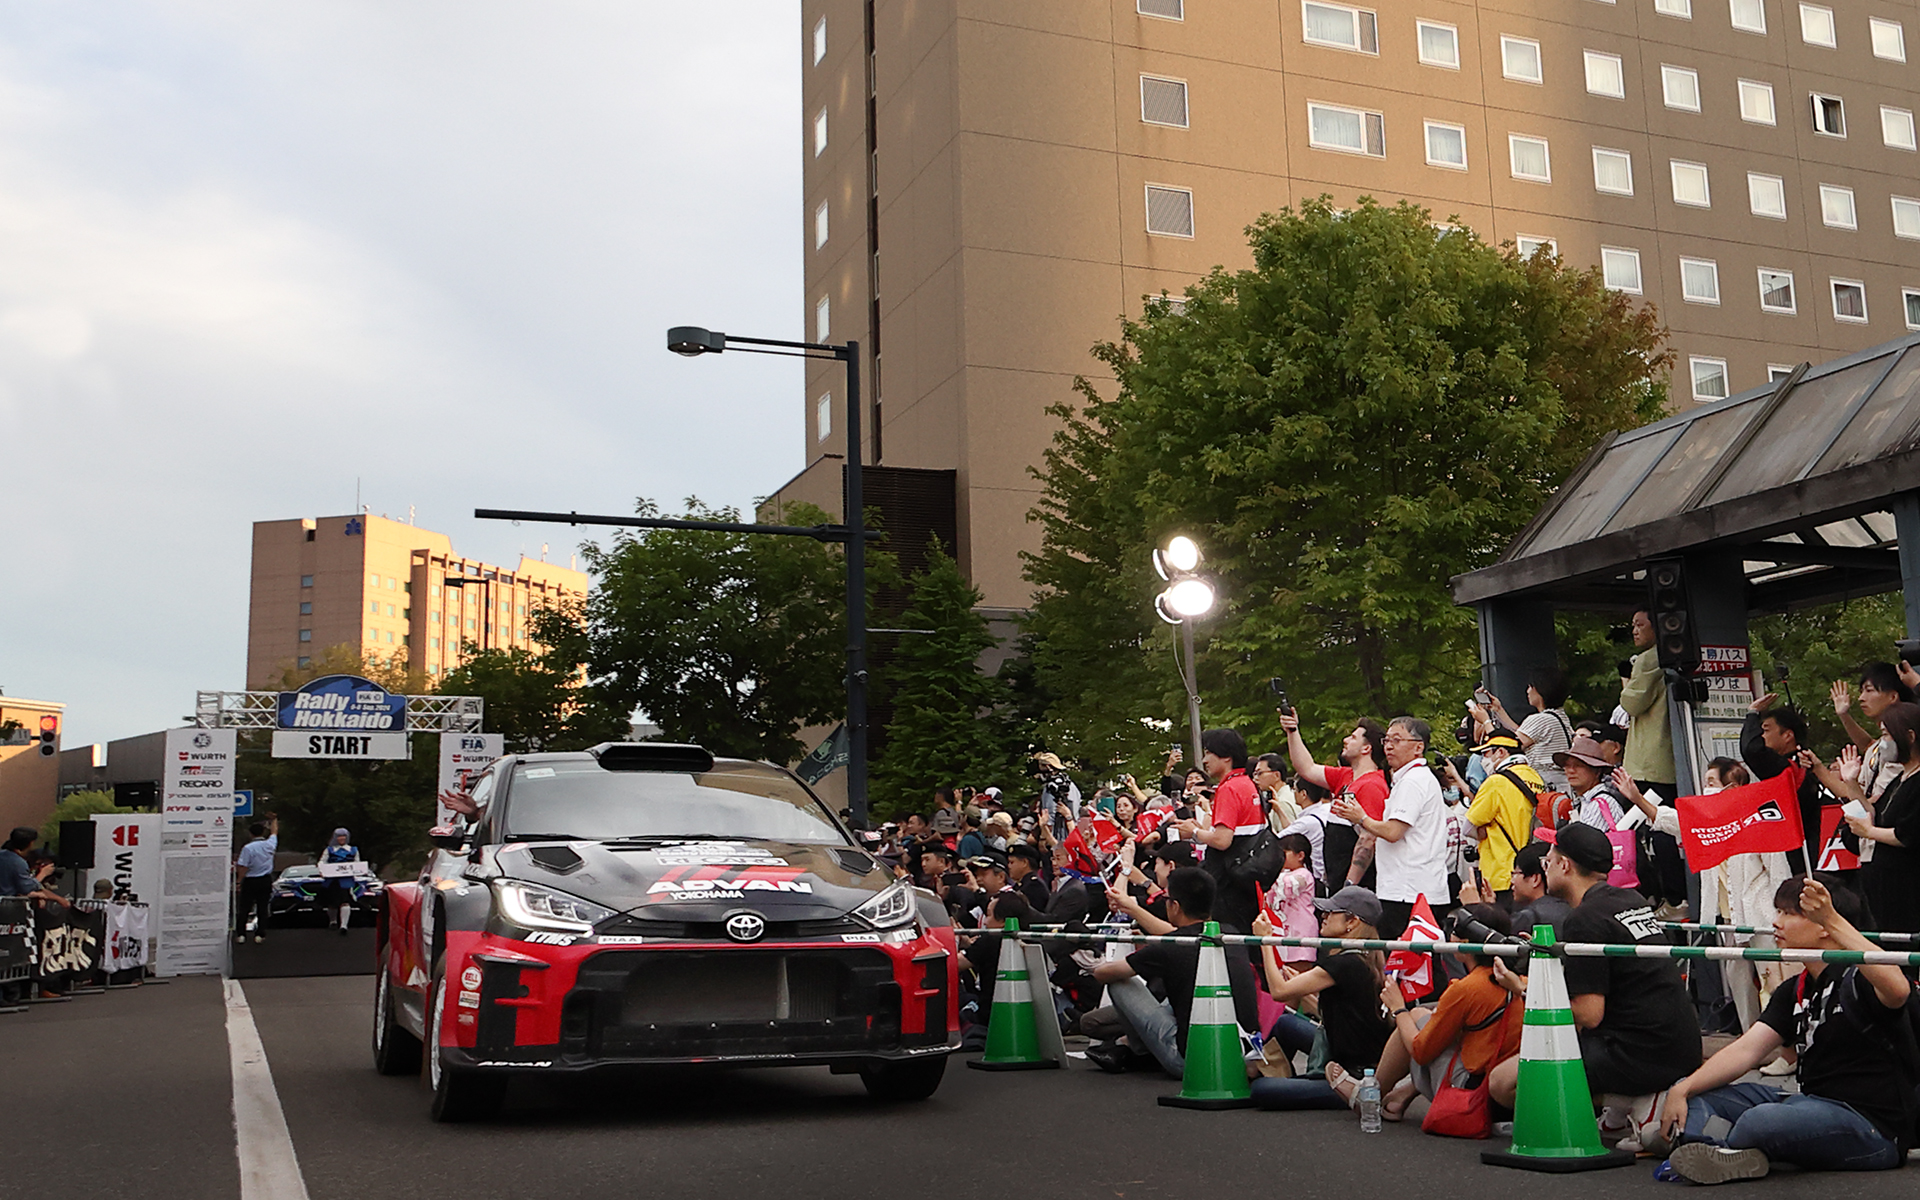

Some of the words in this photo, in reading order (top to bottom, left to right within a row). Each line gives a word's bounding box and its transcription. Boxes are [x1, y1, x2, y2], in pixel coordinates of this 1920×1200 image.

[1701, 648, 1743, 660] 勝バス
[294, 692, 350, 711] Rally
[293, 711, 393, 729] Hokkaido
[309, 735, 371, 755] START
[461, 739, 484, 749] FIA
[178, 780, 223, 788] RECARO
[336, 864, 354, 872] JN-1
[646, 880, 813, 894] ADVAN
[670, 890, 745, 900] YOKOHAMA
[523, 931, 577, 946] KTMS
[893, 929, 918, 941] KTMS
[464, 972, 478, 983] BELL
